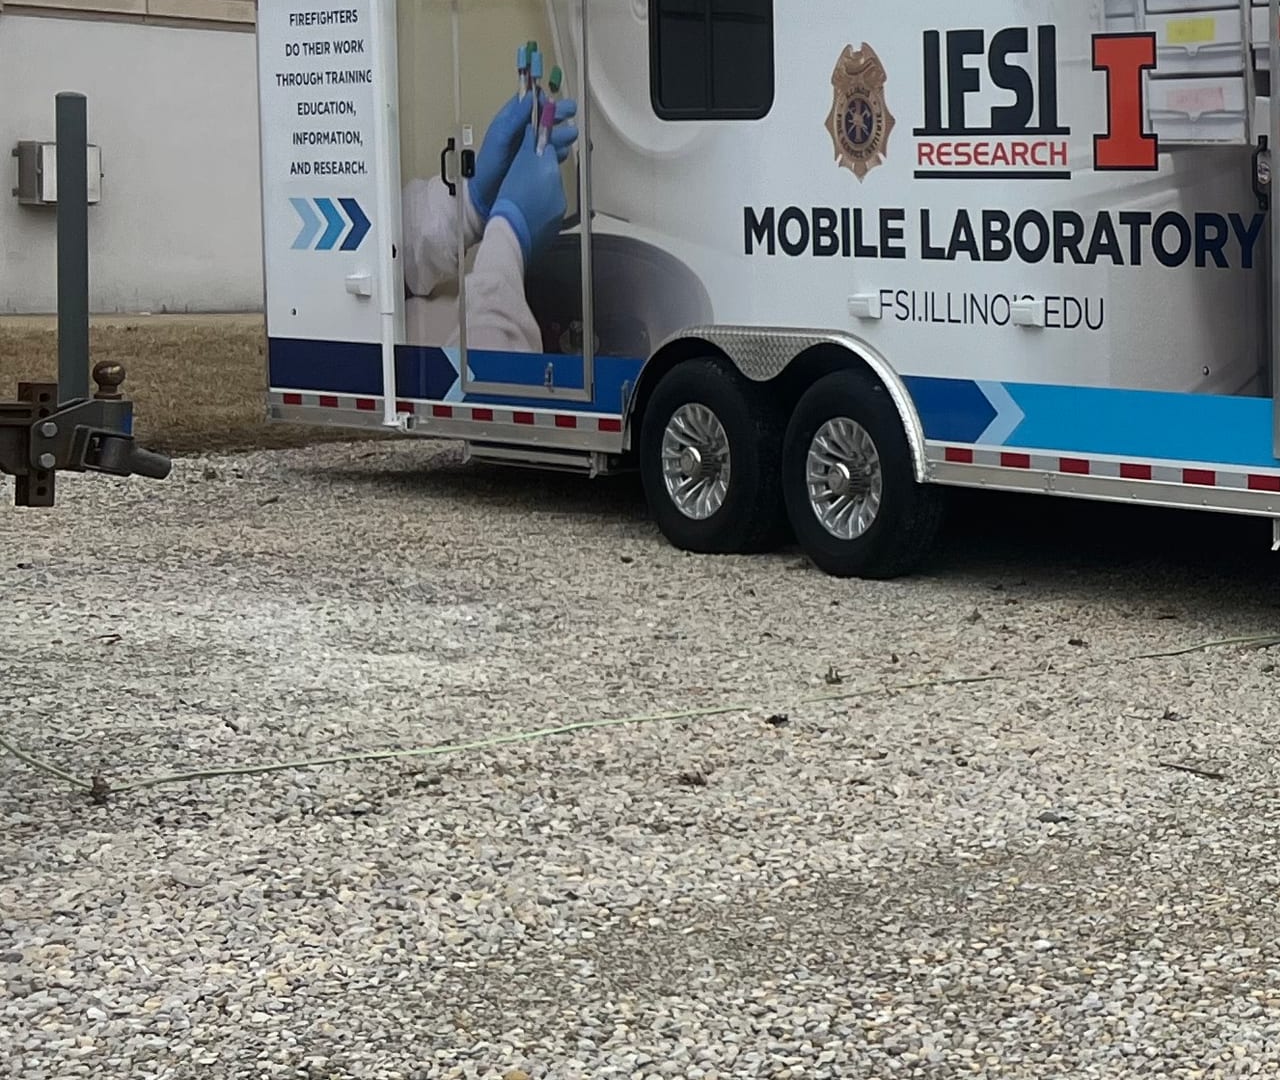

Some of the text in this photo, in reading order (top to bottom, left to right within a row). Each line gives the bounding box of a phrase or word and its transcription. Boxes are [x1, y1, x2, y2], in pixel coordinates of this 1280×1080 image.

[289, 9, 358, 26] FIREFIGHTERS
[285, 39, 364, 57] DO THEIR WORK
[276, 72, 324, 87] THROUGH
[921, 24, 1058, 132] IFSI
[297, 100, 357, 117] EDUCATION,
[292, 130, 363, 147] INFORMATION,
[917, 141, 1068, 167] RESEARCH
[290, 160, 368, 176] AND RESEARCH.
[743, 206, 1266, 269] MOBILE LABORATORY
[876, 289, 1104, 331] FSI.ILLINOEDU
